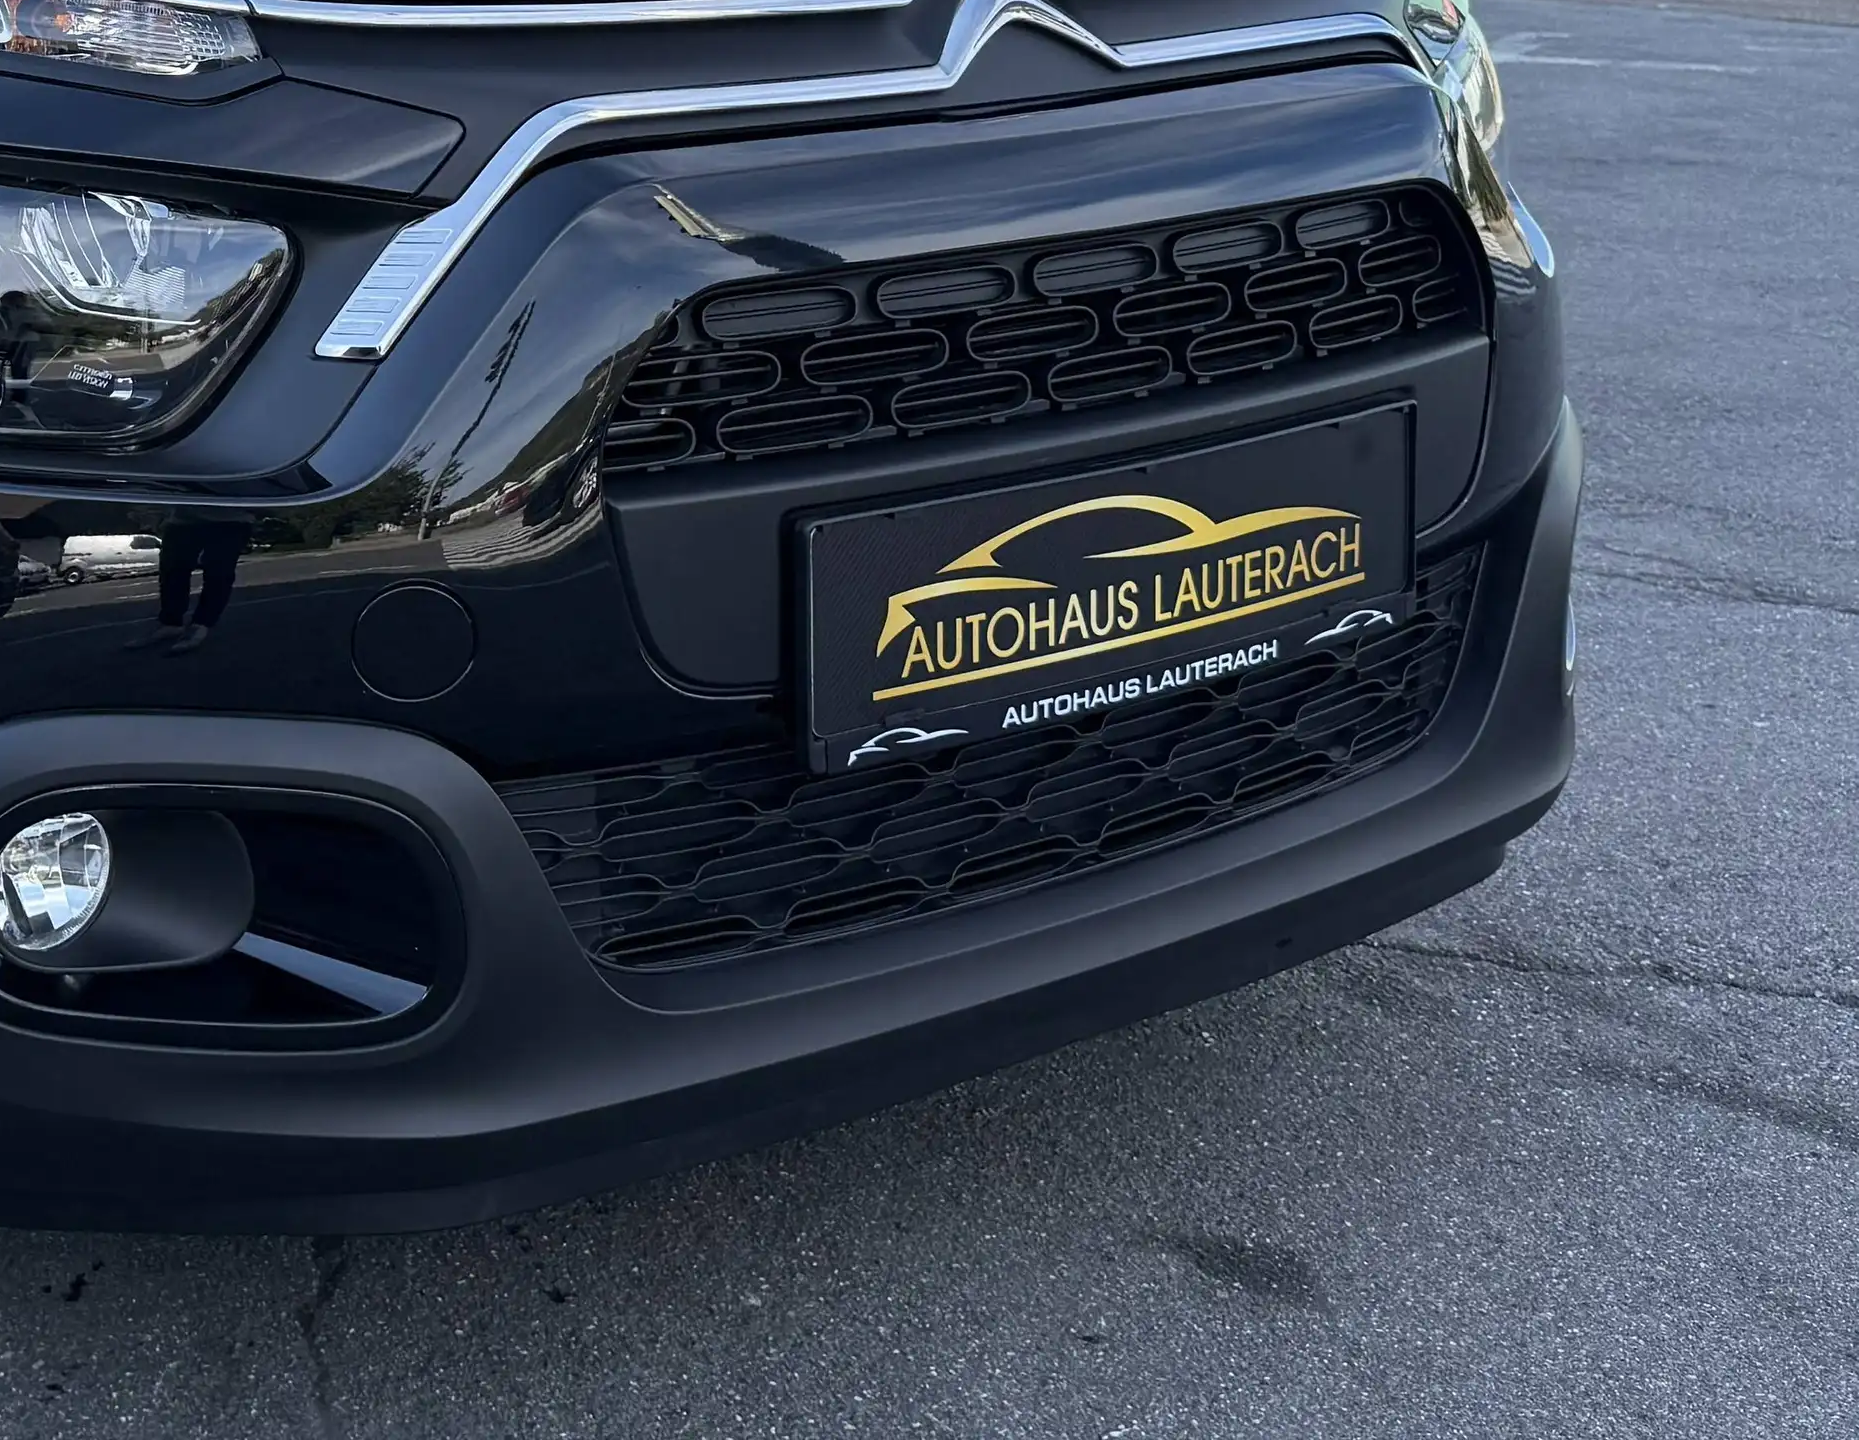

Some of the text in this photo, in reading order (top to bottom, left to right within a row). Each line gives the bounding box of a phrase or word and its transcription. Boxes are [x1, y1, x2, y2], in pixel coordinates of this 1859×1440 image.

[901, 523, 1362, 679] AUTOHAUS LAUTERACH
[1002, 639, 1279, 729] AUTOHAUS LAUTERACH
